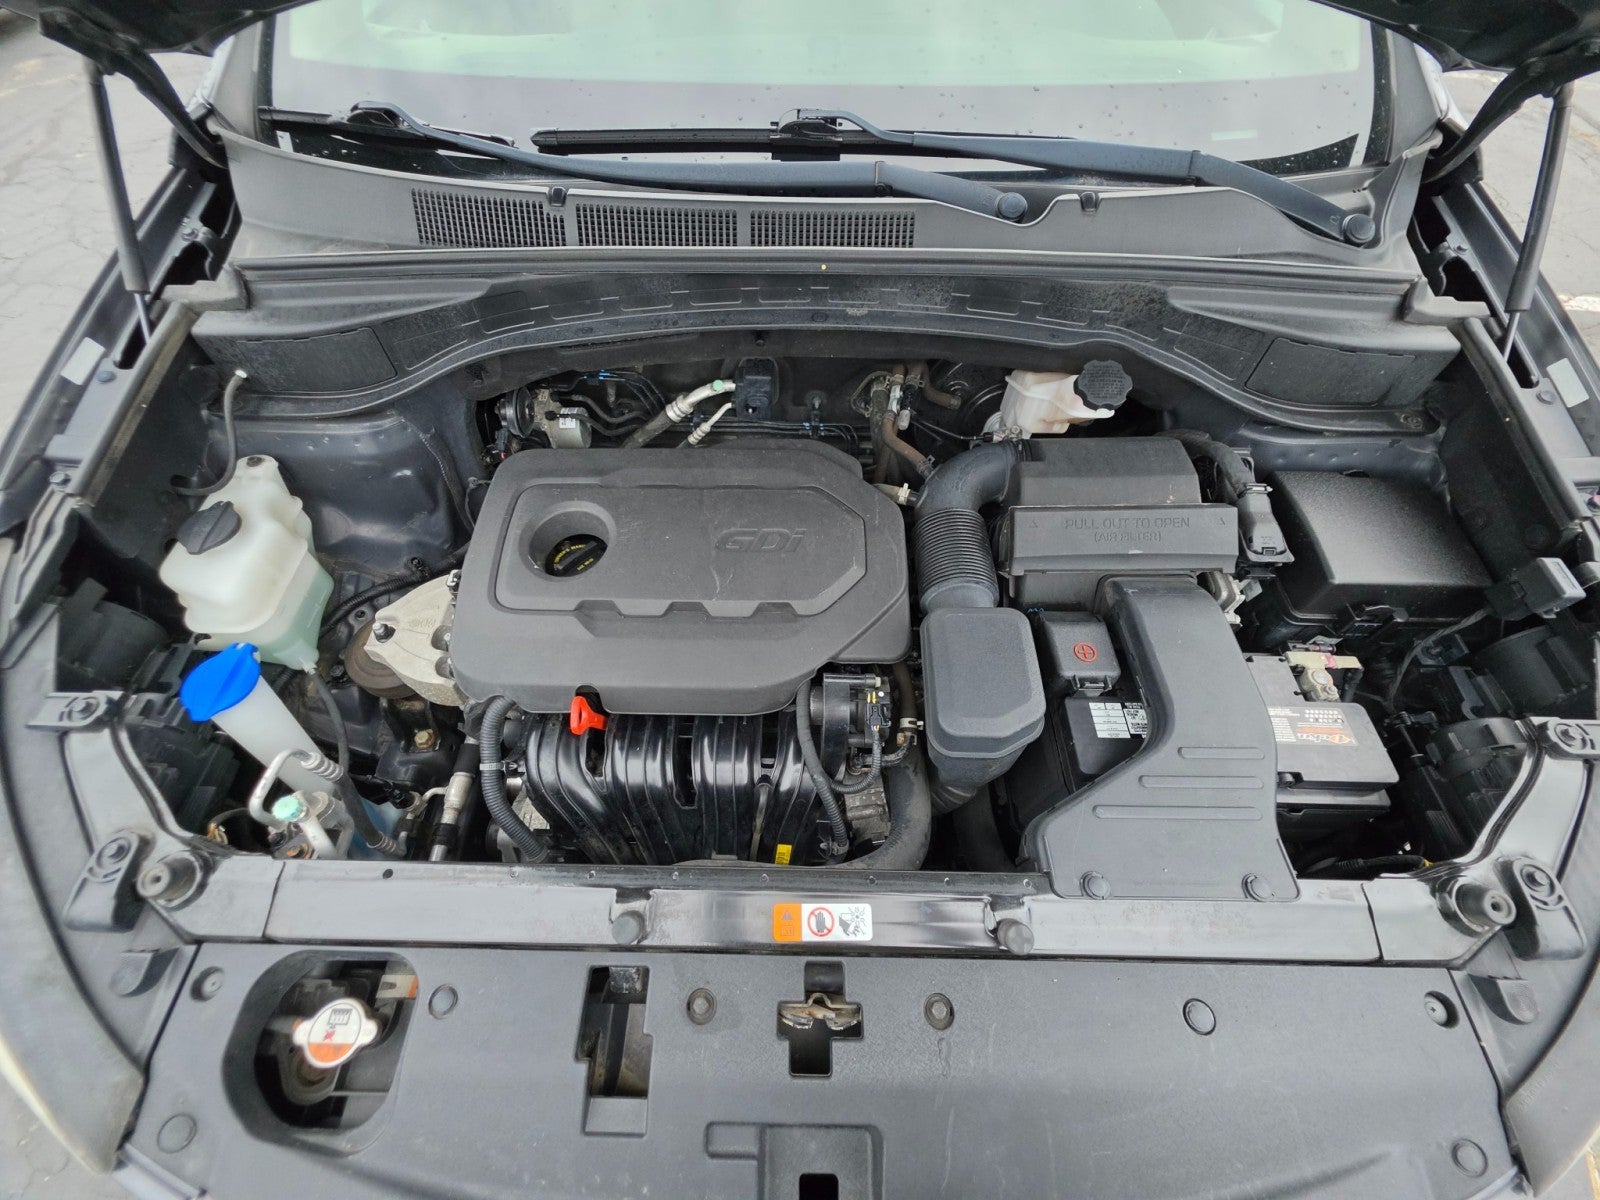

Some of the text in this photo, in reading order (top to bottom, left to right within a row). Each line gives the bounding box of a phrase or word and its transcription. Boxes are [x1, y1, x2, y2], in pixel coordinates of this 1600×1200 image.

[1064, 517, 1191, 530] PULL OUT TO OPEN
[1093, 531, 1118, 543] (AIR
